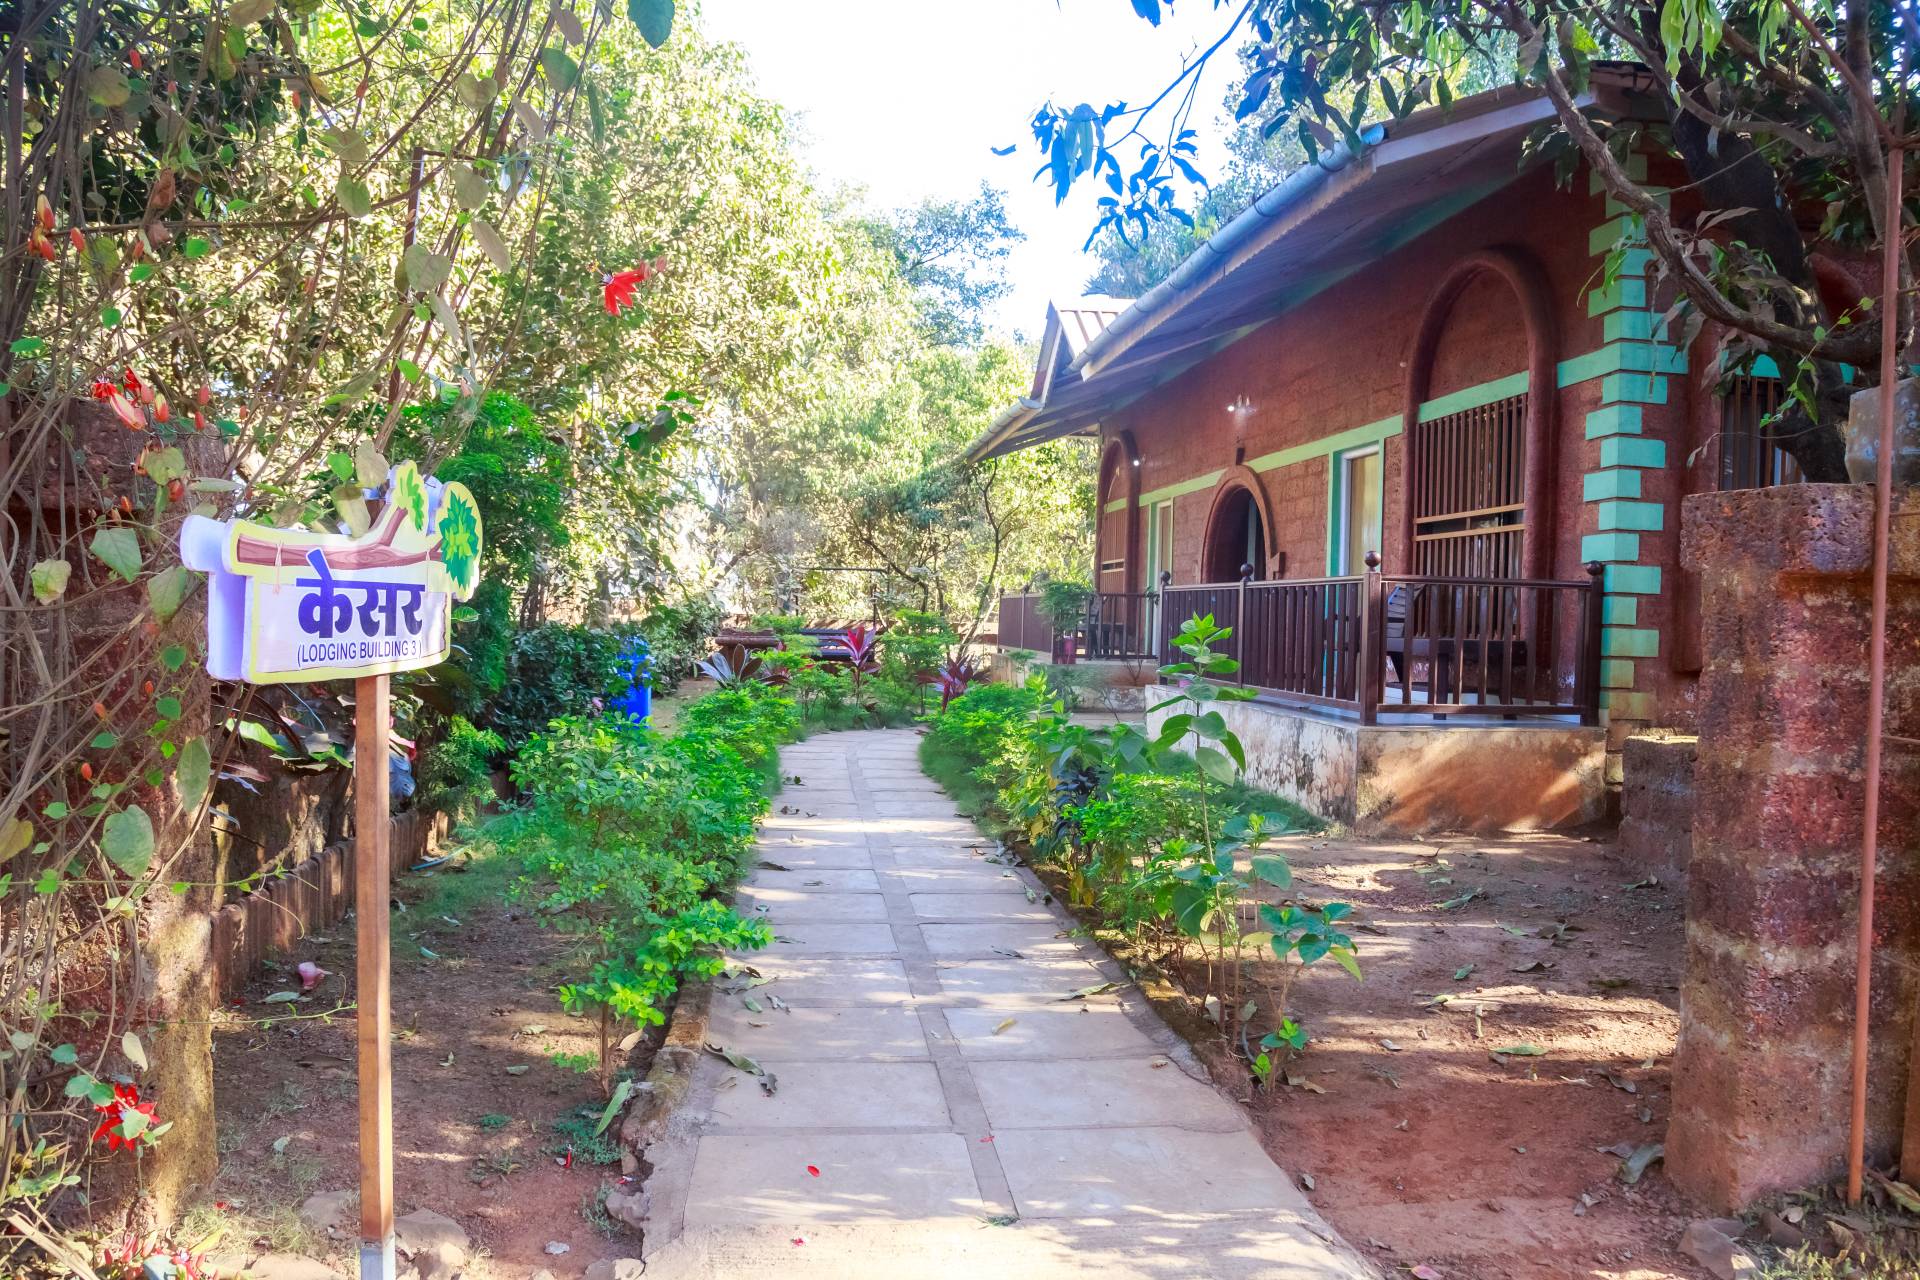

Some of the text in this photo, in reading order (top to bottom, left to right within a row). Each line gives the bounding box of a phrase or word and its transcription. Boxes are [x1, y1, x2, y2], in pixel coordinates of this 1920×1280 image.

[296, 549, 426, 639] केसर
[297, 643, 357, 667] (LODGING
[359, 640, 409, 659] BUILDING
